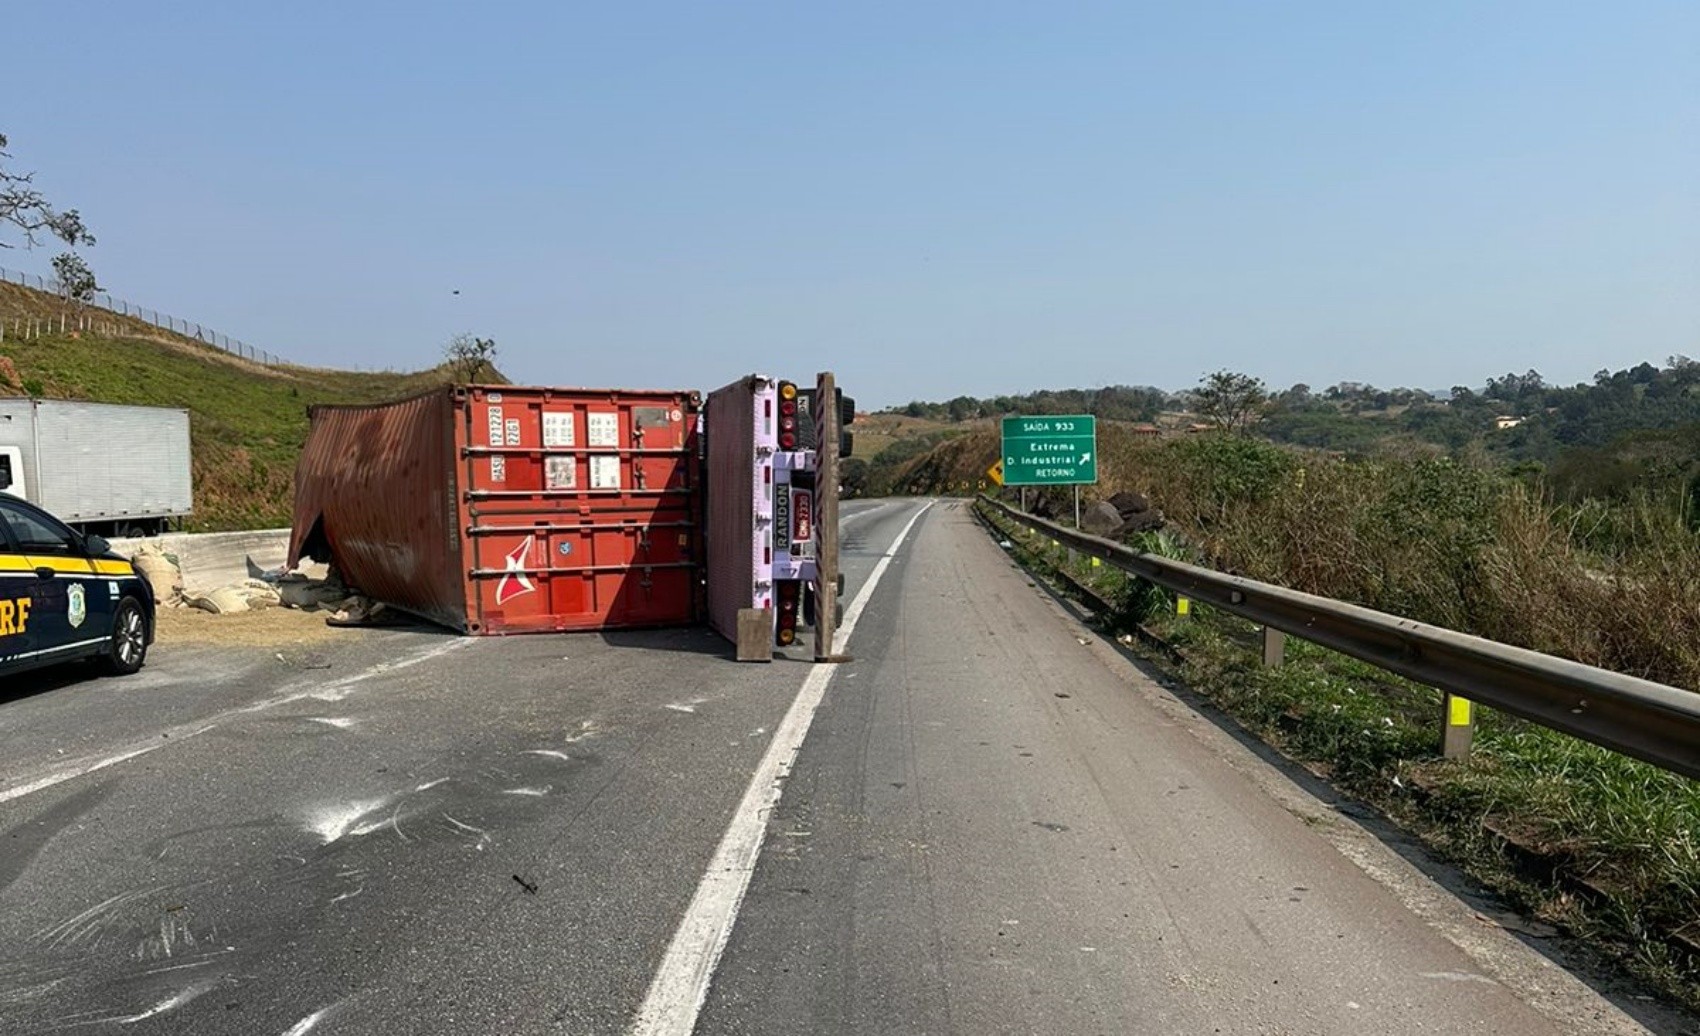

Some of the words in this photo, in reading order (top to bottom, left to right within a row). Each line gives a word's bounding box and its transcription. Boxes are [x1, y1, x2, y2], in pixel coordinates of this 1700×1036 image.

[507, 420, 518, 443] 22G1
[1023, 421, 1050, 432] SAÍDA
[1055, 422, 1075, 431] 933
[1030, 443, 1075, 451] Extrema
[1021, 456, 1075, 464] Industrial
[1035, 468, 1076, 477] RETORNO
[777, 485, 787, 547] RANDON
